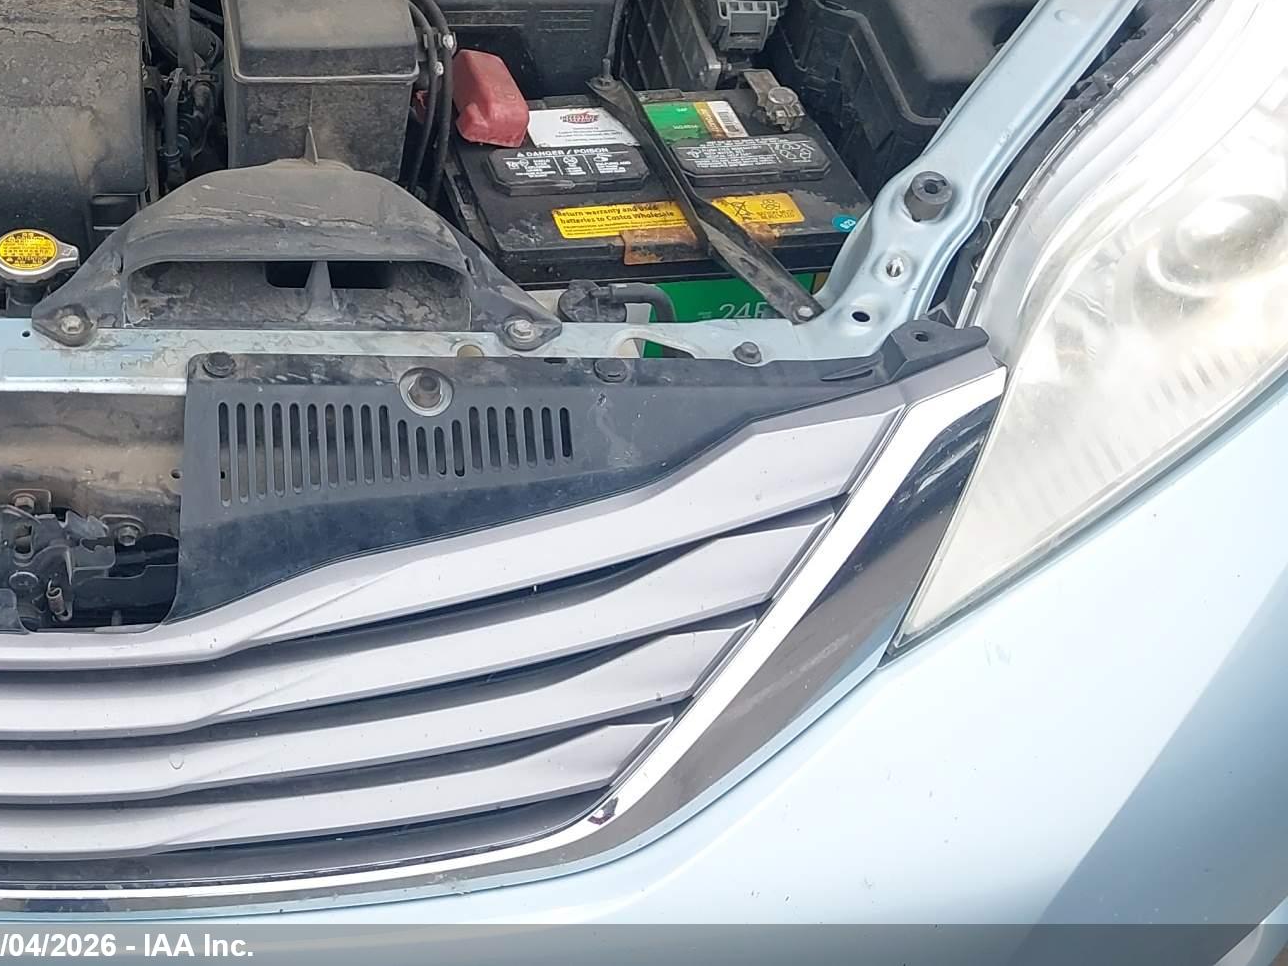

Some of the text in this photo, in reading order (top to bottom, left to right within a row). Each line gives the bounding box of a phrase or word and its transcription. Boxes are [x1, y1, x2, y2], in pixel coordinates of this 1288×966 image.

[526, 149, 564, 157] DANGER
[556, 209, 584, 217] Return
[585, 207, 621, 216] warranty
[622, 205, 639, 213] and
[560, 216, 596, 225] batteries
[606, 213, 632, 222] Costco
[633, 210, 674, 220] Wholesale
